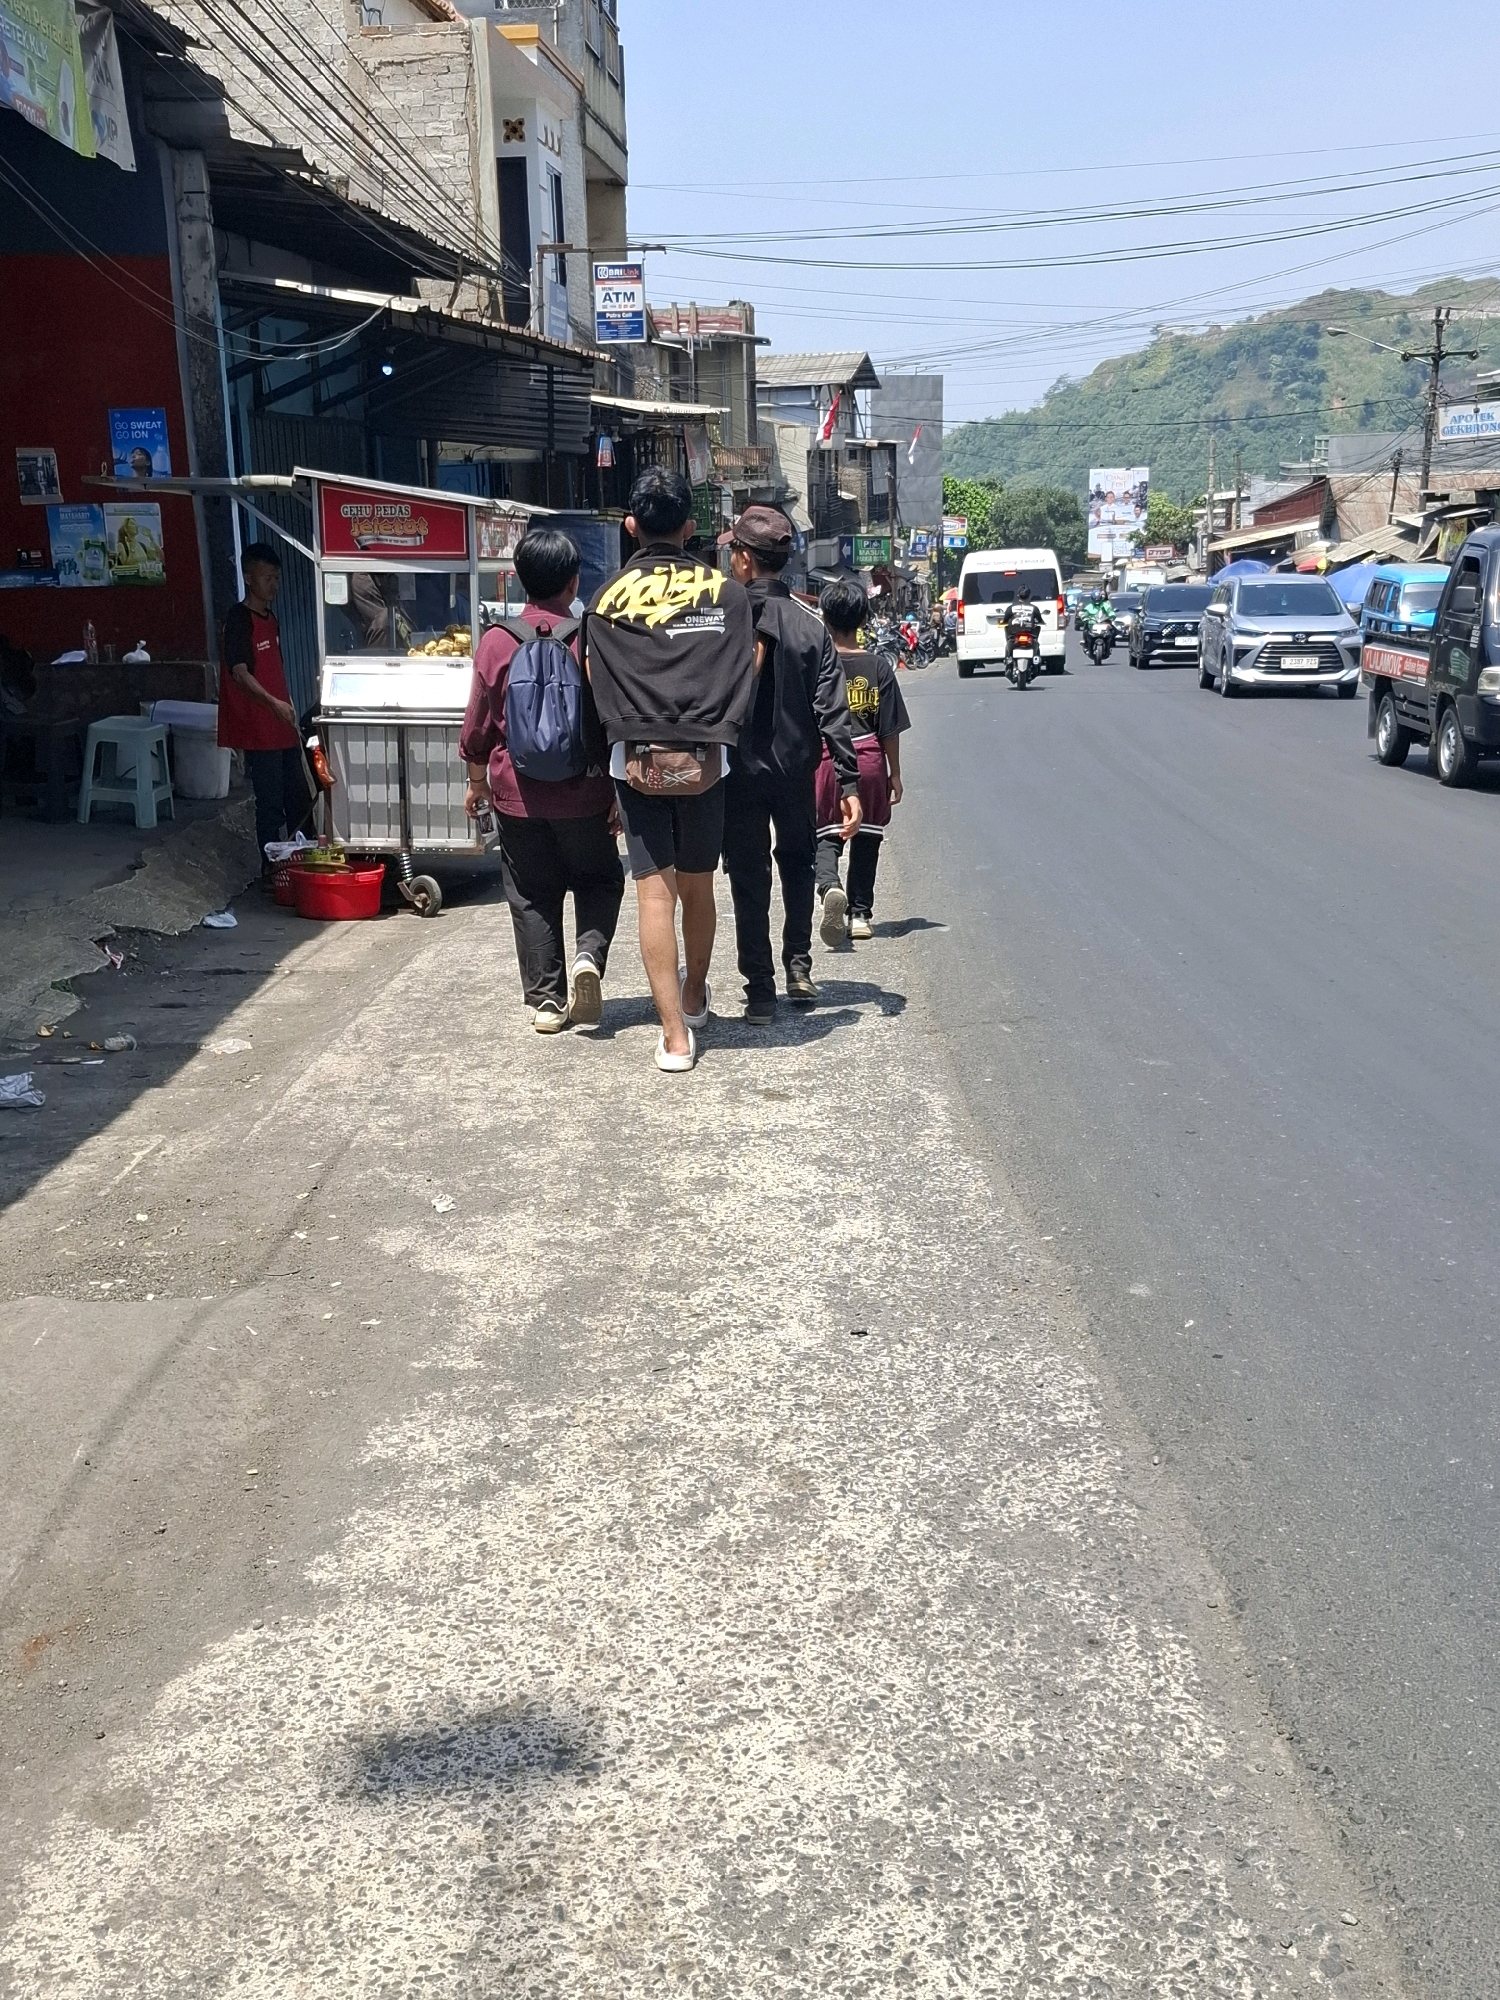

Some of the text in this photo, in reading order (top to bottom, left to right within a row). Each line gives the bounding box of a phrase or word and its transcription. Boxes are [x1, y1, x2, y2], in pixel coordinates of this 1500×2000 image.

[602, 291, 635, 304] ATM
[1450, 412, 1495, 424] APOTEK
[114, 421, 162, 430] GO SWEAT
[1441, 422, 1500, 437] GEKBRON
[115, 430, 149, 439] GO ION
[341, 504, 411, 517] GEHU PEDAS
[863, 540, 870, 548] P
[684, 614, 726, 624] ONEWAY
